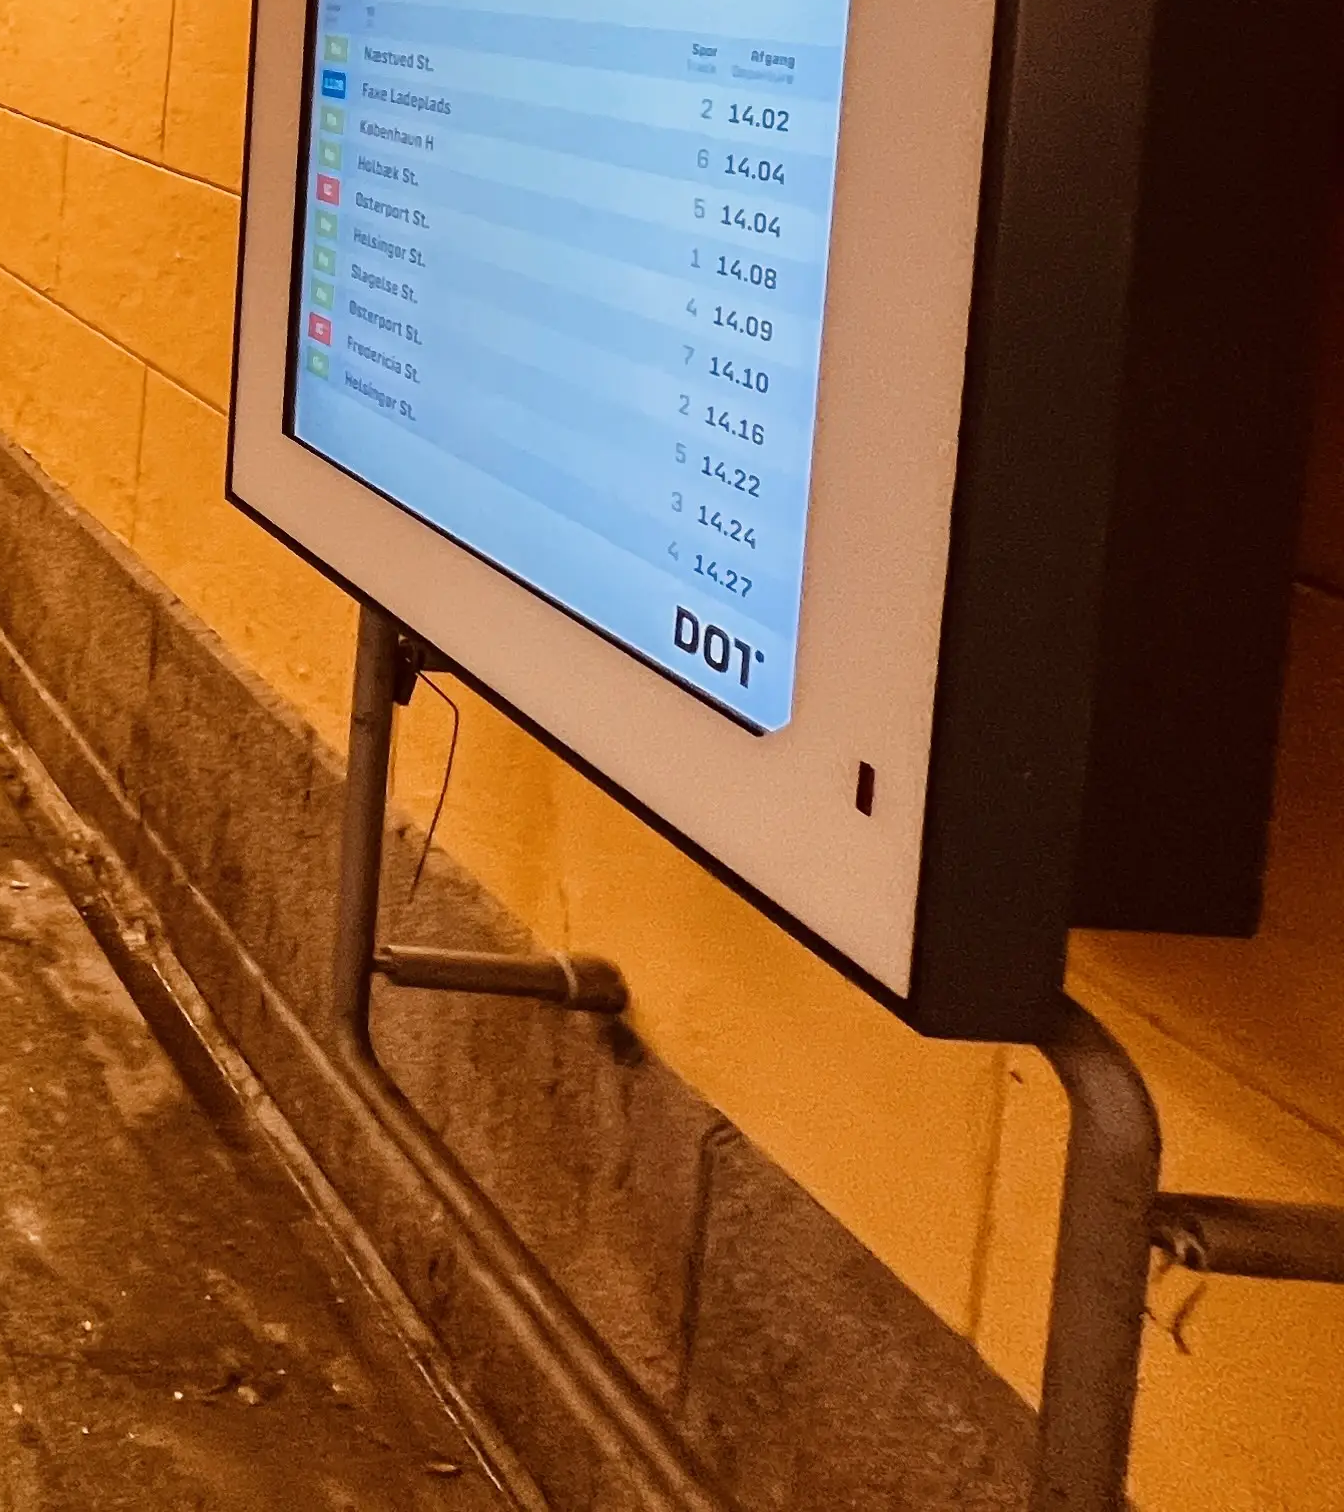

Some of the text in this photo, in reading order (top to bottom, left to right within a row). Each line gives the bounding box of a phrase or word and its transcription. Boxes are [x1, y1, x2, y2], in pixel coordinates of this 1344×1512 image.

[363, 45, 414, 69] Næstved
[416, 53, 435, 72] St.
[750, 49, 796, 70] Afgang
[362, 82, 388, 102] Faxe
[390, 87, 452, 116] Ladeplads
[700, 98, 790, 133] 2 14.02
[424, 134, 434, 152] H
[357, 155, 400, 181] Holbæk
[402, 167, 419, 187] St.
[696, 148, 786, 186] 6 14.04
[412, 209, 430, 230] St.
[693, 197, 781, 239] 5 14.04
[408, 247, 426, 268] St.
[690, 248, 778, 290] 1 14.08
[401, 283, 418, 304] St.
[405, 324, 423, 346] St.
[685, 297, 774, 342] 4 14.09
[404, 363, 421, 385] St.
[682, 344, 770, 395] 7 14.10
[399, 399, 417, 422] St.
[678, 393, 765, 447] 2 14.16
[674, 442, 761, 499] 5 14.22
[670, 491, 756, 550] 3 14.24
[666, 540, 753, 598] 4 14.27
[674, 604, 755, 689] DOT
